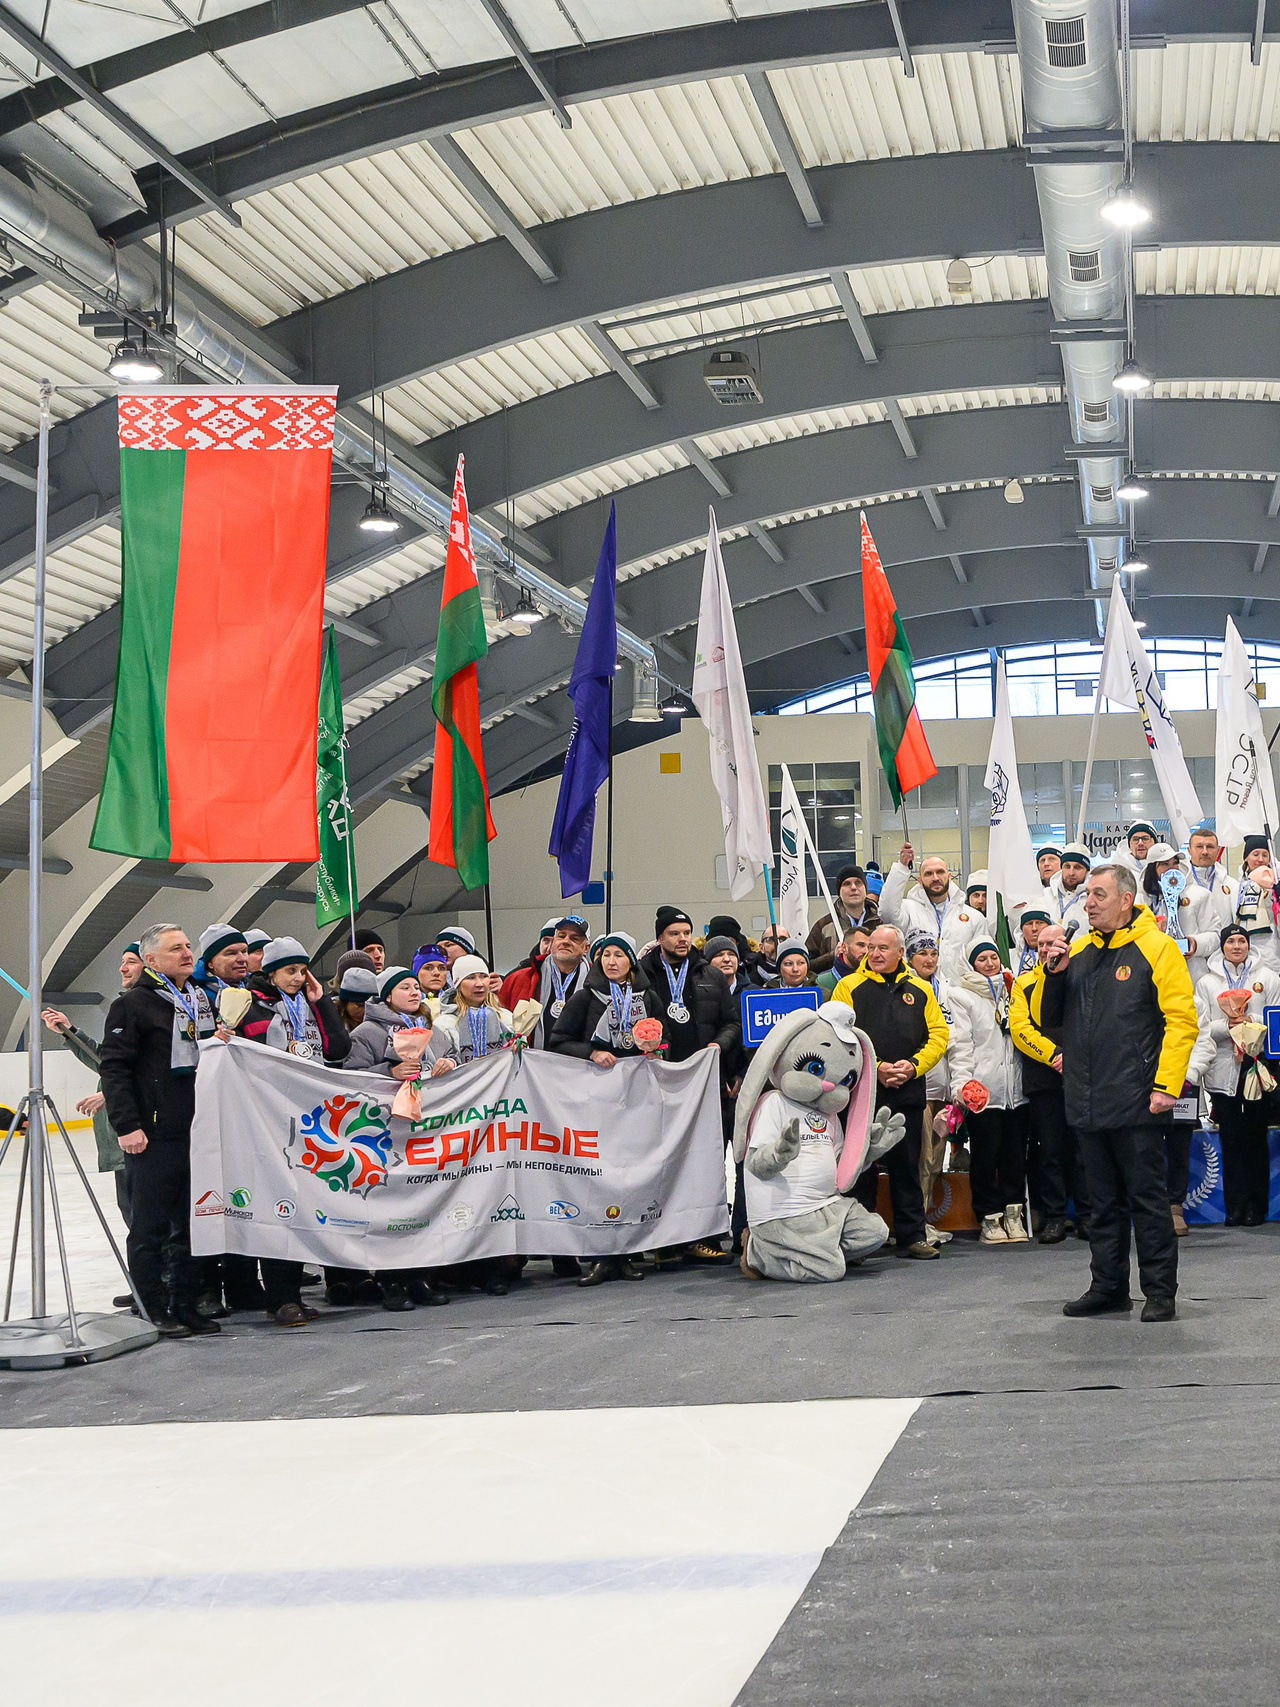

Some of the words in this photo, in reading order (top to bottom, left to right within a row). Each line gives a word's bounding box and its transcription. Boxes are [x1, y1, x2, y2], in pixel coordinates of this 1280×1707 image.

[1019, 1032, 1044, 1056] BELARUS
[410, 1098, 529, 1132] КОМАНДА
[405, 1121, 600, 1171] ЕДИНЫЕ
[406, 1173, 439, 1185] КОГДА
[441, 1170, 459, 1181] МЫ
[506, 1160, 522, 1170] МЫ
[525, 1161, 603, 1177] НЕПОБЕДИМЫ!
